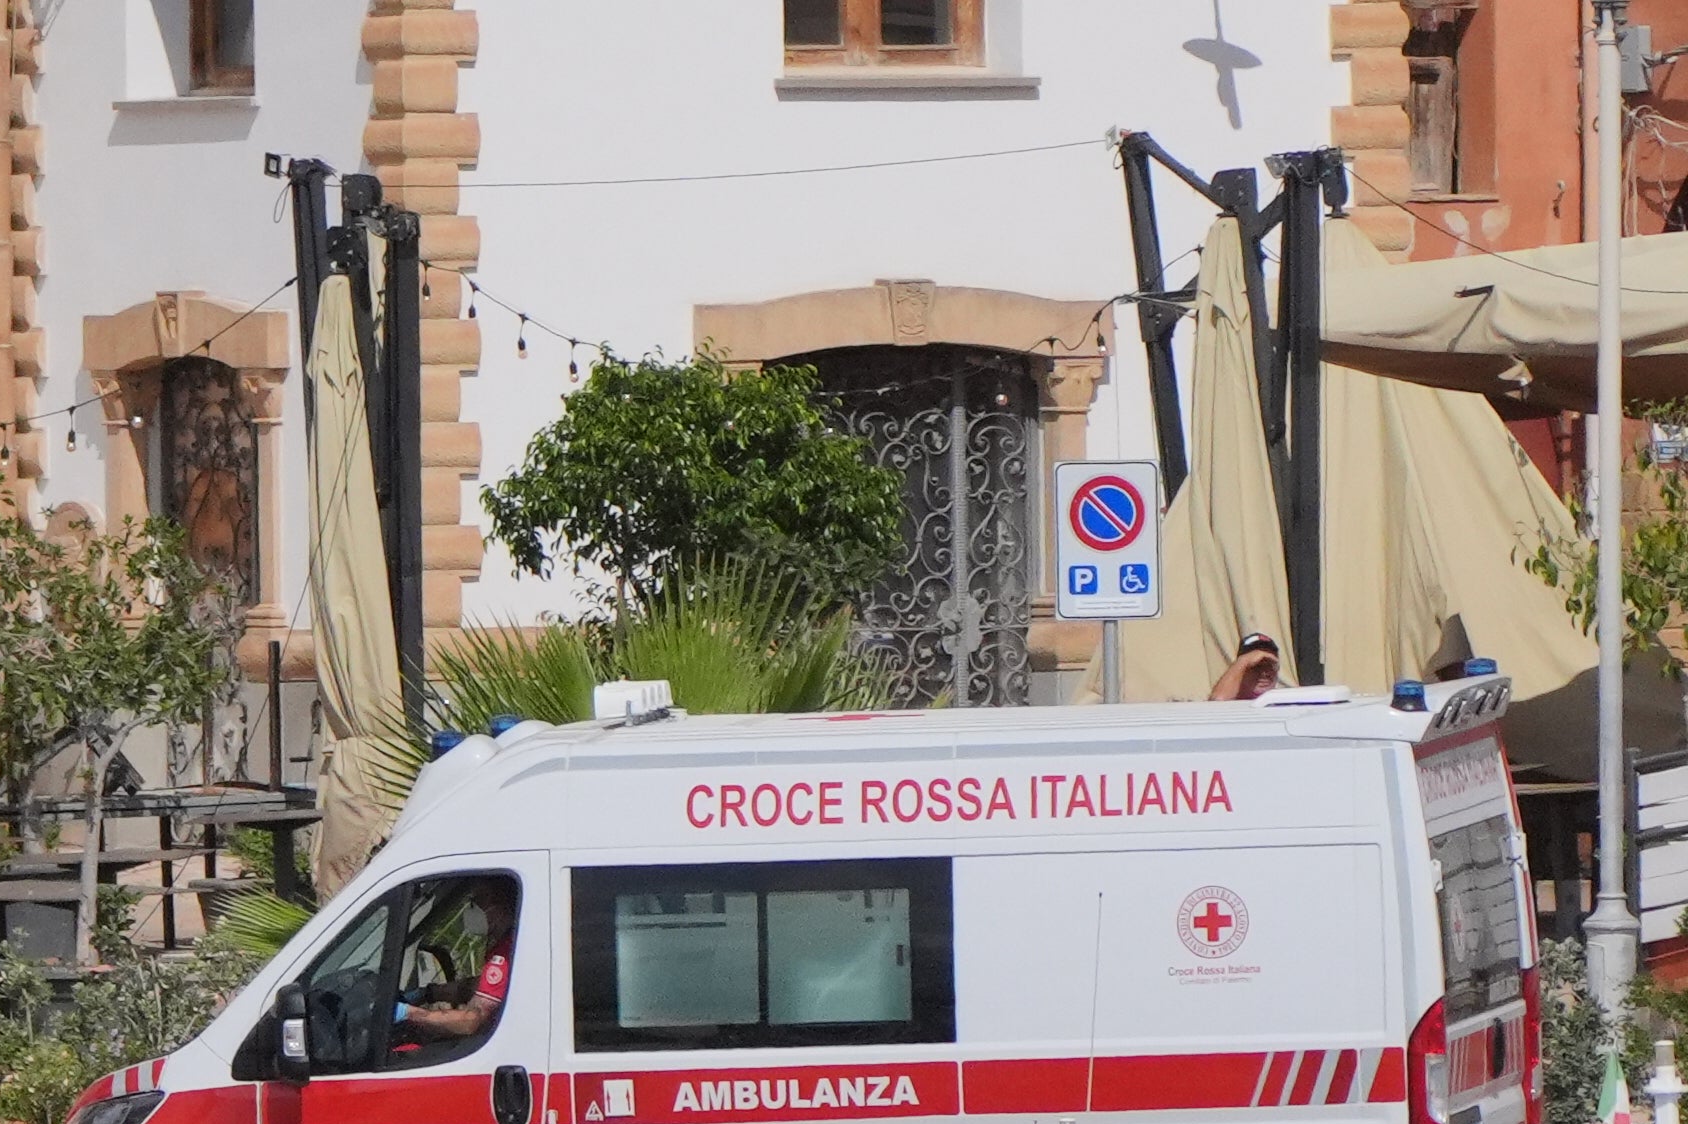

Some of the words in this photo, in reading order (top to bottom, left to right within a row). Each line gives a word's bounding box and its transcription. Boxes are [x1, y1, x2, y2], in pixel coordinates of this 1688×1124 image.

[1074, 568, 1094, 593] P
[686, 781, 844, 829] CROCE
[861, 777, 1017, 824] ROSSA
[1030, 770, 1234, 819] ITALIANA
[1167, 966, 1194, 976] Croce
[1196, 965, 1226, 975] Rossa
[1227, 964, 1262, 975] Italiana
[673, 1076, 921, 1113] AMBULANZA
